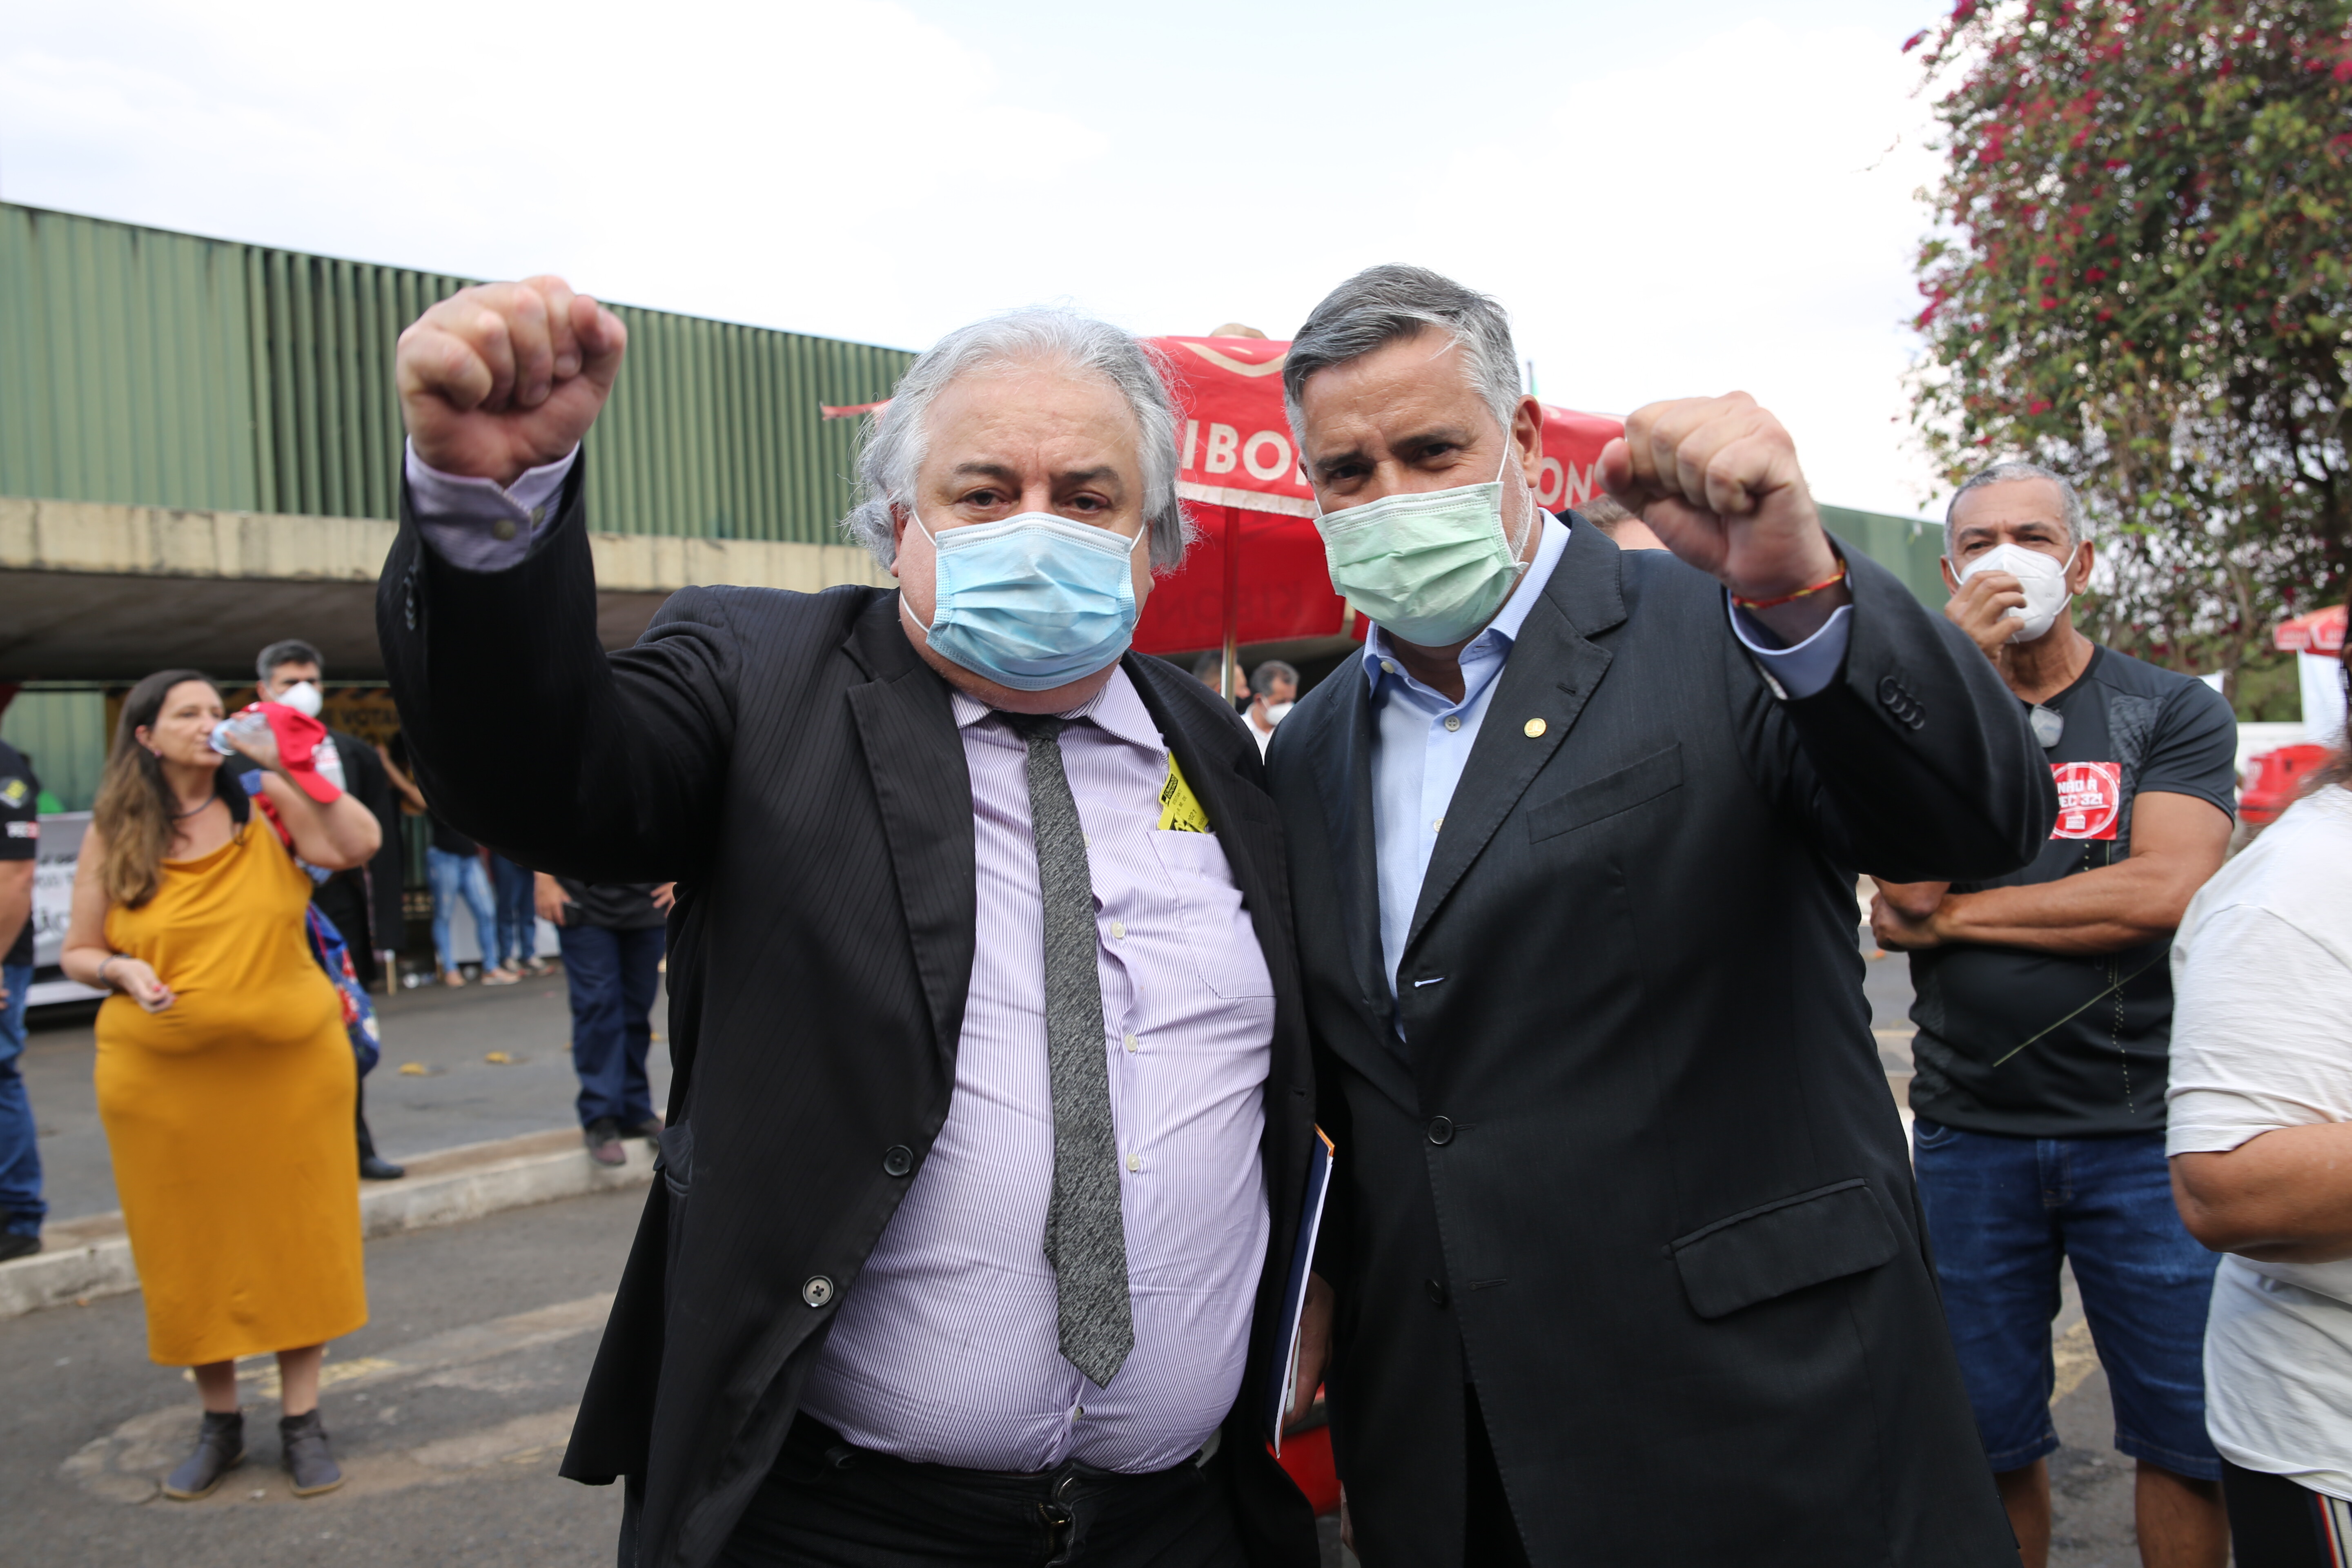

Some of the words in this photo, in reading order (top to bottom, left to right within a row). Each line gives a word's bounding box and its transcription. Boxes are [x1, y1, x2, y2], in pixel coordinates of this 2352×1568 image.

[1181, 419, 1308, 486] IBO
[2057, 778, 2084, 794] NÃO
[2080, 792, 2103, 806] 32!
